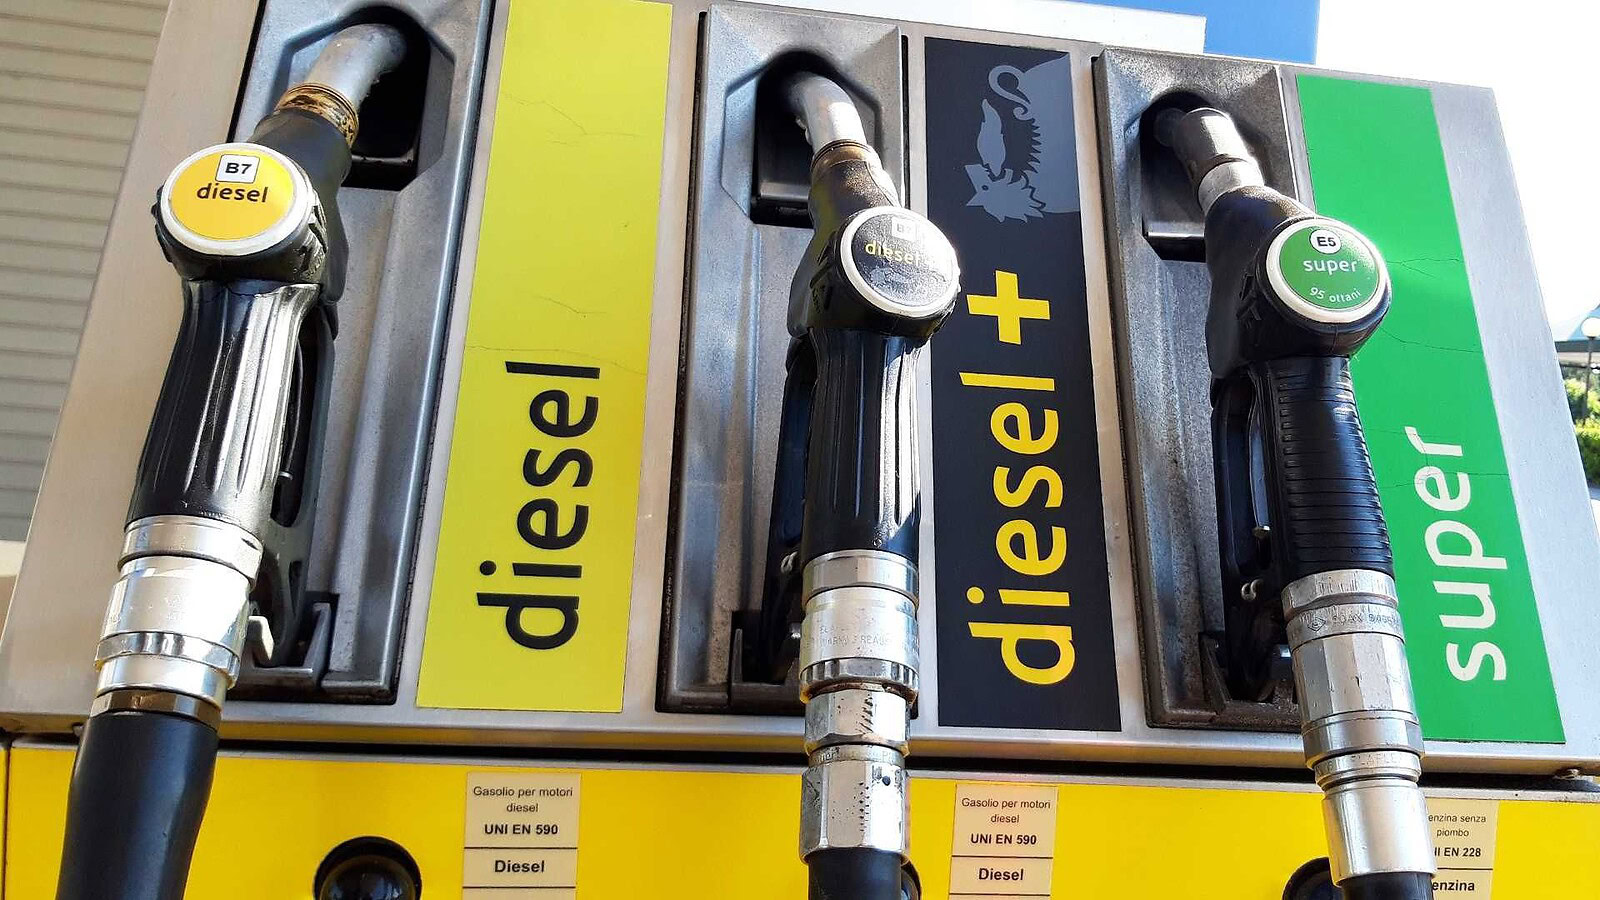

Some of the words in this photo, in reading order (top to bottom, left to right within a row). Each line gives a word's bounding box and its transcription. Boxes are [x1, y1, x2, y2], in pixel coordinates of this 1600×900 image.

[225, 162, 252, 175] B7
[196, 183, 269, 203] diesel
[1316, 236, 1337, 247] E5
[1303, 259, 1358, 275] super
[1310, 287, 1326, 299] 95
[1329, 288, 1361, 303] ottani
[476, 361, 600, 650] diesel
[1404, 426, 1507, 682] super
[473, 786, 515, 797] Gasolio
[518, 788, 536, 798] per
[539, 787, 573, 797] motori
[506, 803, 539, 813] diesel
[961, 797, 999, 808] Gasolio
[1001, 800, 1018, 809] per
[1020, 799, 1051, 809] motori
[990, 814, 1020, 824] diesel
[1428, 813, 1458, 822] enzina
[1460, 815, 1487, 823] senza
[484, 824, 508, 835] UNI
[512, 824, 531, 835] EN
[536, 824, 559, 835] 590
[1436, 829, 1470, 838] piombo
[970, 833, 992, 844] UNI
[995, 834, 1013, 844] EN
[1016, 834, 1037, 845] 590
[1444, 847, 1460, 857] EN
[1463, 847, 1482, 858] 228
[494, 860, 545, 873] Diesel
[978, 867, 1024, 881] Diesel
[1432, 880, 1475, 891] enzina
